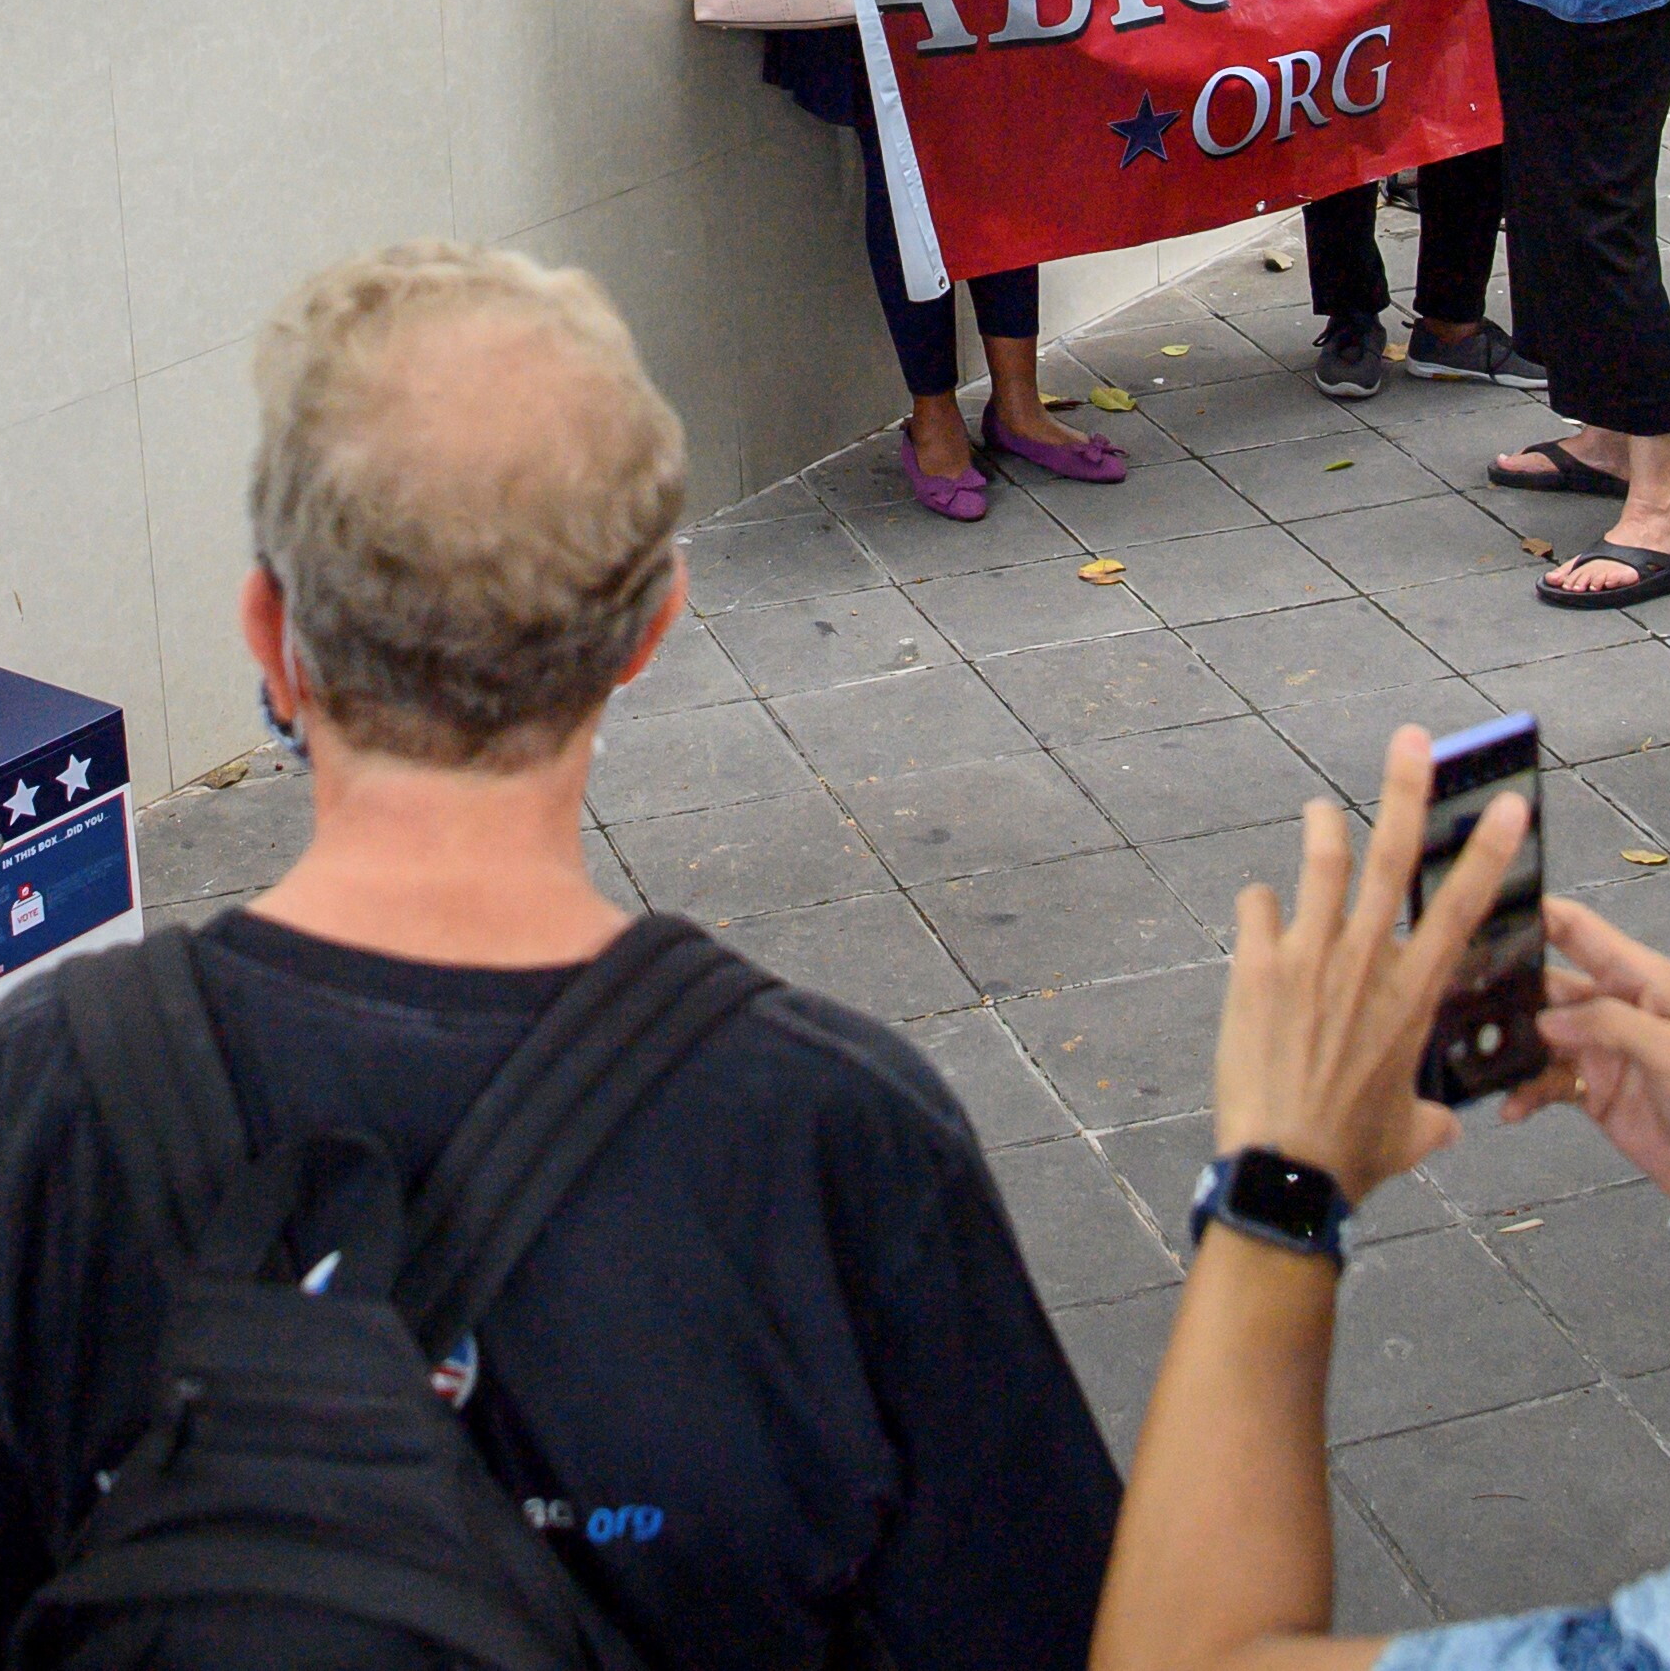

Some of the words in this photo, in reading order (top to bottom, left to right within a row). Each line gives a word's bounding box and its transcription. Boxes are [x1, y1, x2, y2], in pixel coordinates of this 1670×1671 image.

[2, 858, 13, 870] IN
[14, 844, 37, 863] THIS
[16, 907, 39, 924] VOTE
